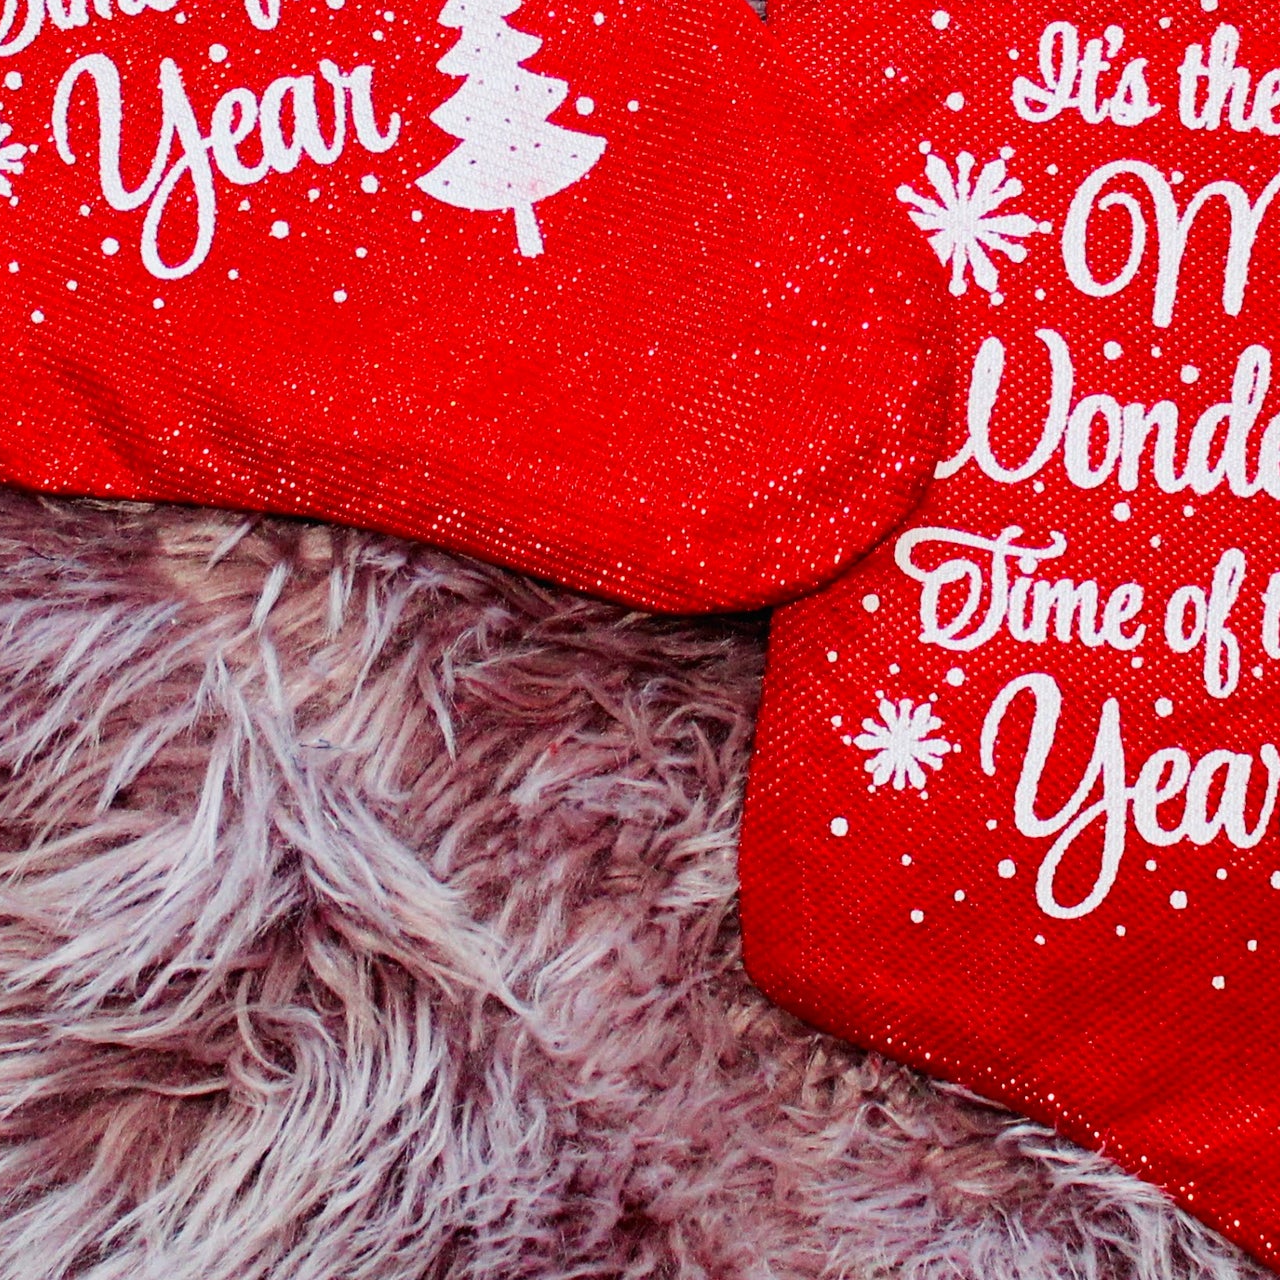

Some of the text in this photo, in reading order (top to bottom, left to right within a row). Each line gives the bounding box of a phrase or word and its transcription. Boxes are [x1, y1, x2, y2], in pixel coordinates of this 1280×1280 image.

[1010, 19, 1162, 127] It's
[51, 52, 401, 281] Year
[894, 525, 1146, 652] Time
[1164, 547, 1247, 699] of
